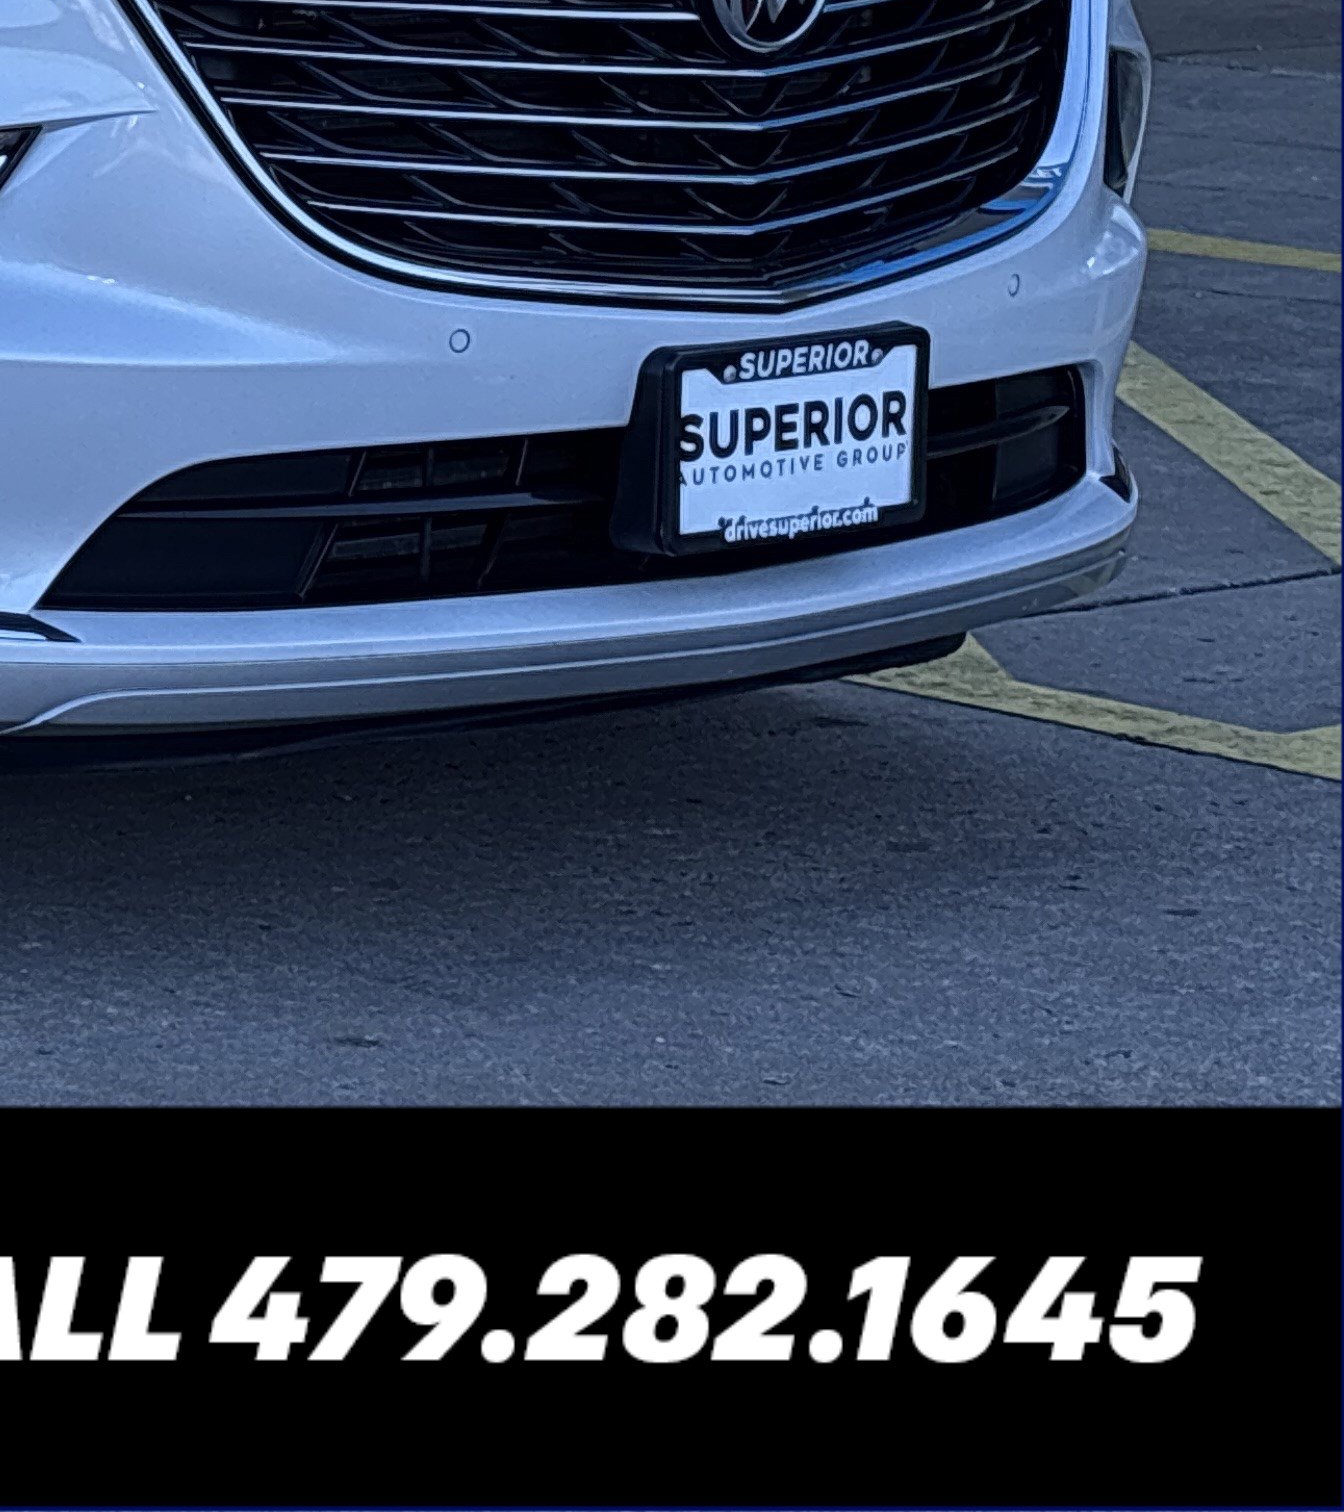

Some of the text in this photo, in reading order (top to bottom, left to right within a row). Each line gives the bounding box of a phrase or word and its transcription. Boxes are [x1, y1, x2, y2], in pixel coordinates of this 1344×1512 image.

[739, 339, 870, 382] SUPERIOR
[679, 390, 907, 463] SUPERIOR
[836, 442, 908, 469] GROUP
